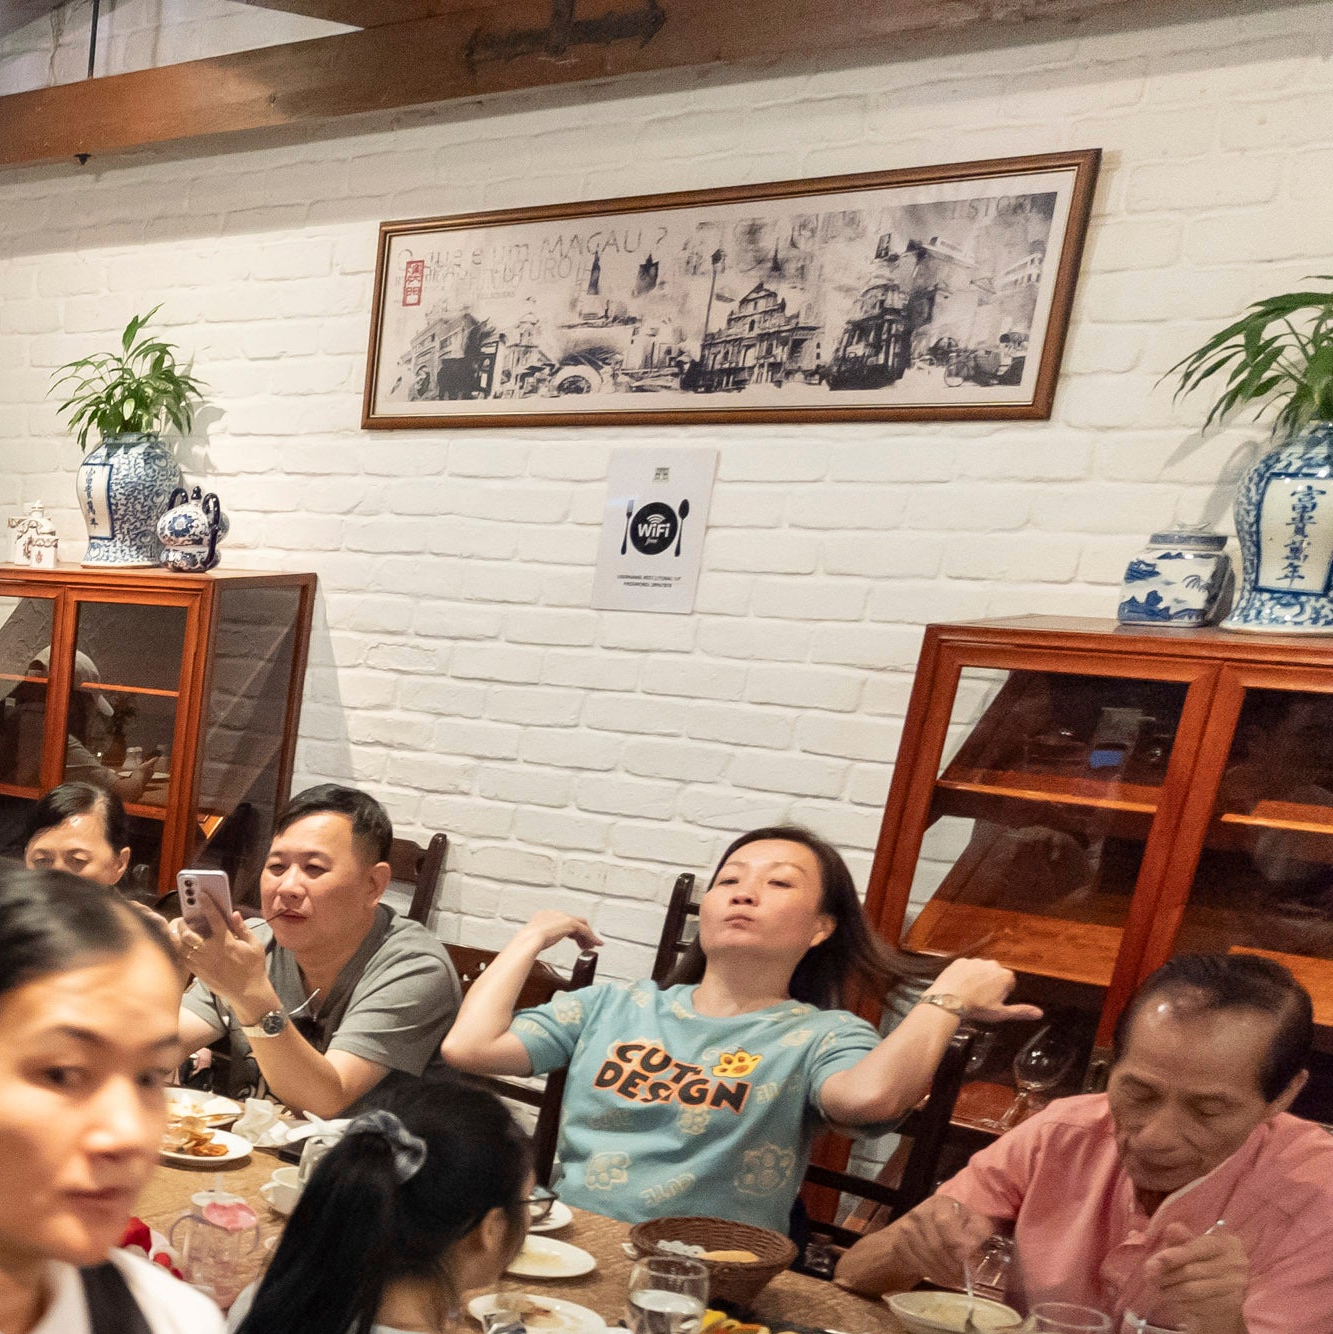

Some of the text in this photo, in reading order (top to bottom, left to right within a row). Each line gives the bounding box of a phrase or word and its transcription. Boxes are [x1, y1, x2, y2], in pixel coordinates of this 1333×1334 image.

[637, 521, 671, 538] WiFi
[615, 1042, 704, 1085] CUT
[594, 1060, 751, 1115] DESGN
